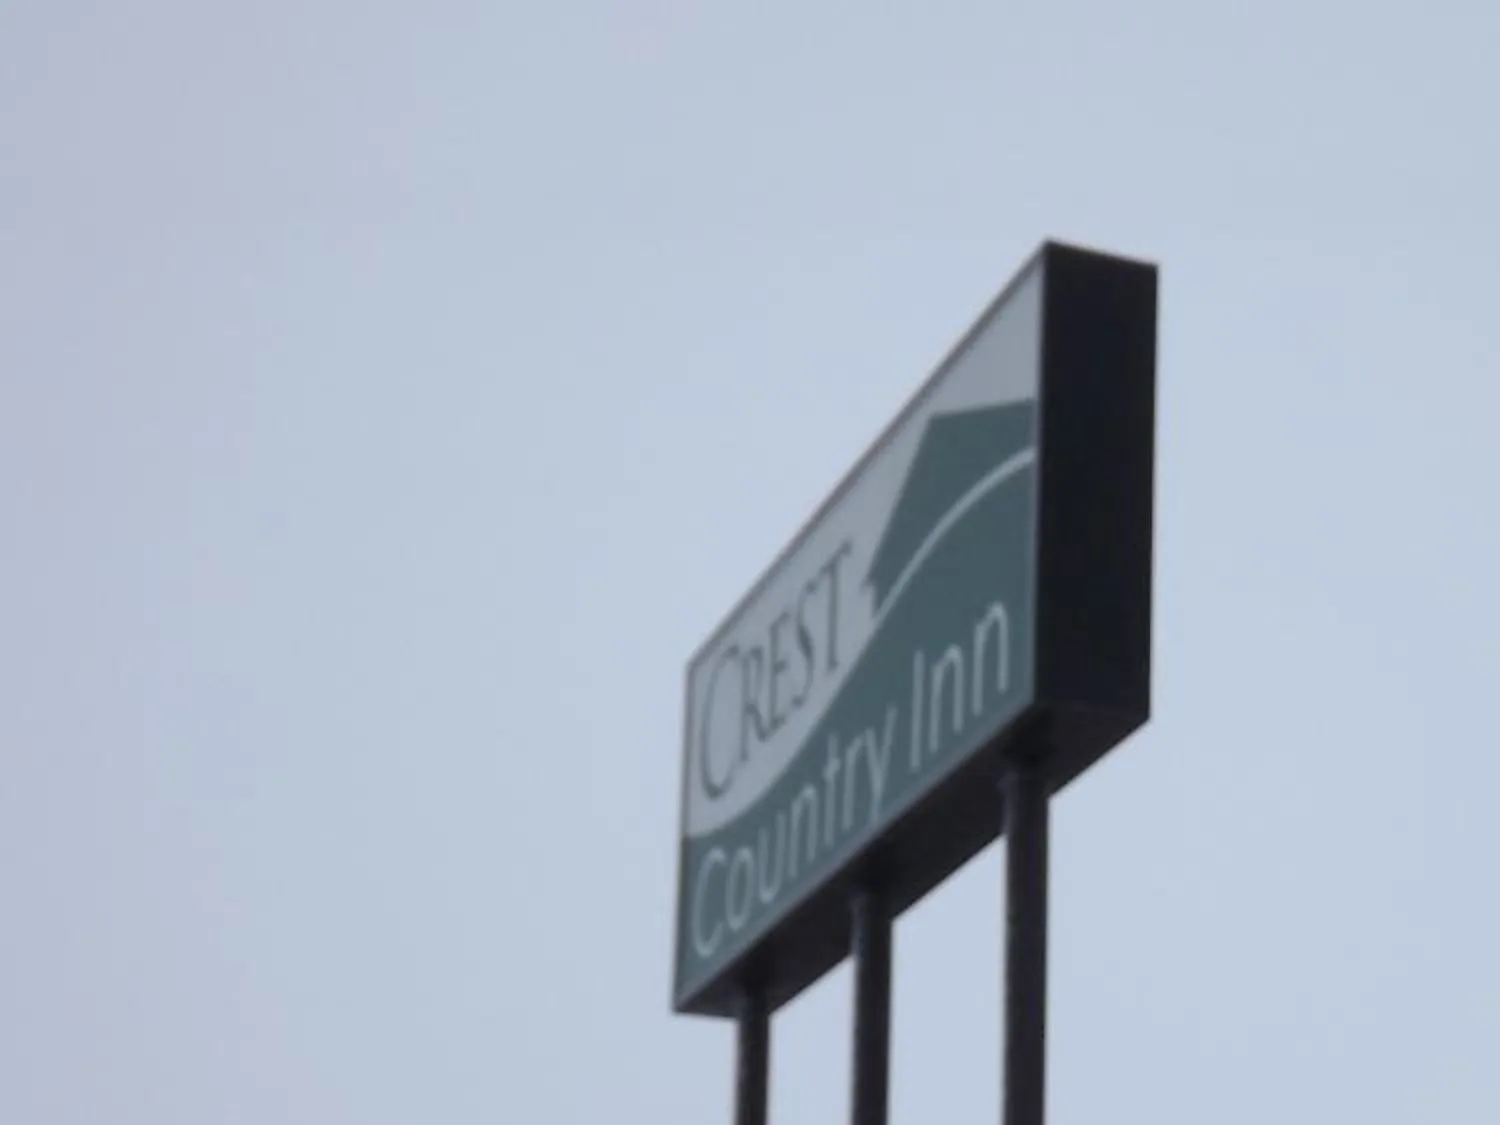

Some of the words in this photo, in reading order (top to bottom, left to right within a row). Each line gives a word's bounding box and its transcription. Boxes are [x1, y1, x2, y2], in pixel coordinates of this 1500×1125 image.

[693, 705, 898, 957] Country
[909, 600, 1009, 773] Inn
[701, 539, 853, 800] CREST
